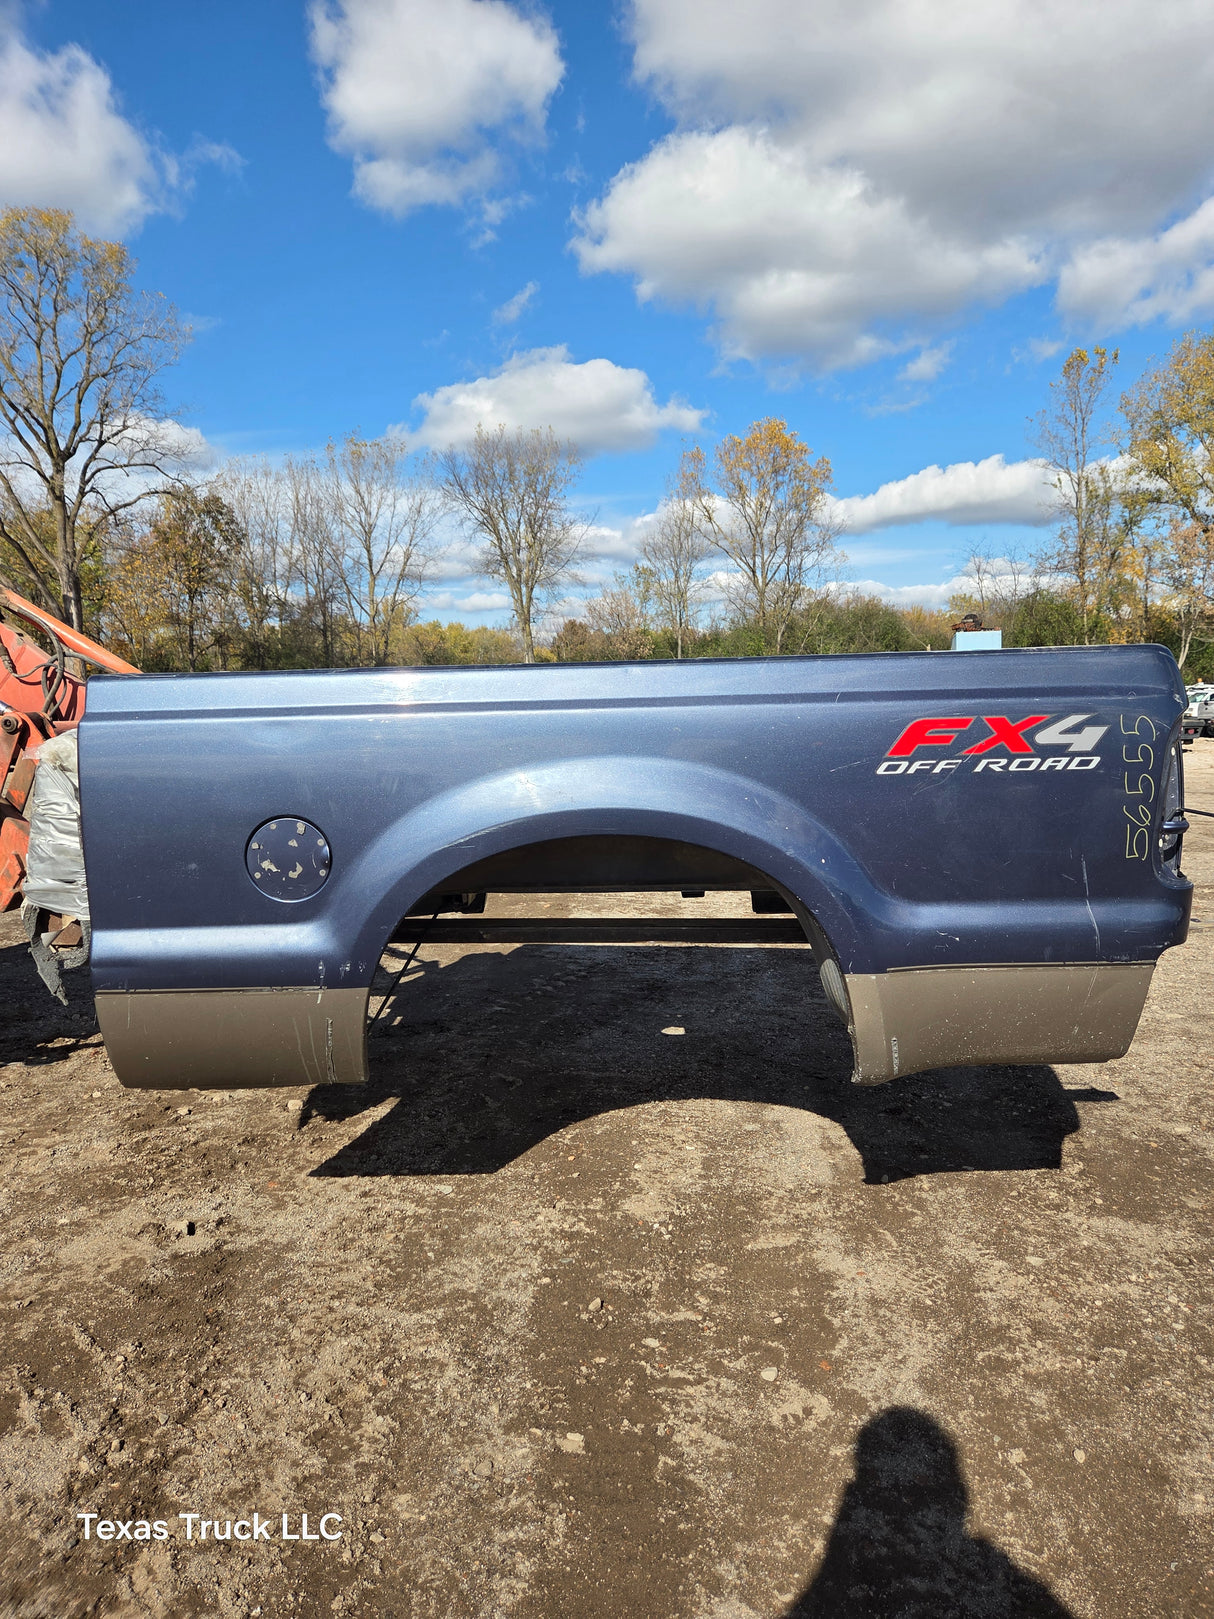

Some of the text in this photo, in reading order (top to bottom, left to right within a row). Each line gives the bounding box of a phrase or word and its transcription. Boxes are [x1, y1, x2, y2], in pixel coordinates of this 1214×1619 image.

[886, 713, 1111, 757] FX4
[875, 756, 1102, 775] OFF ROAD
